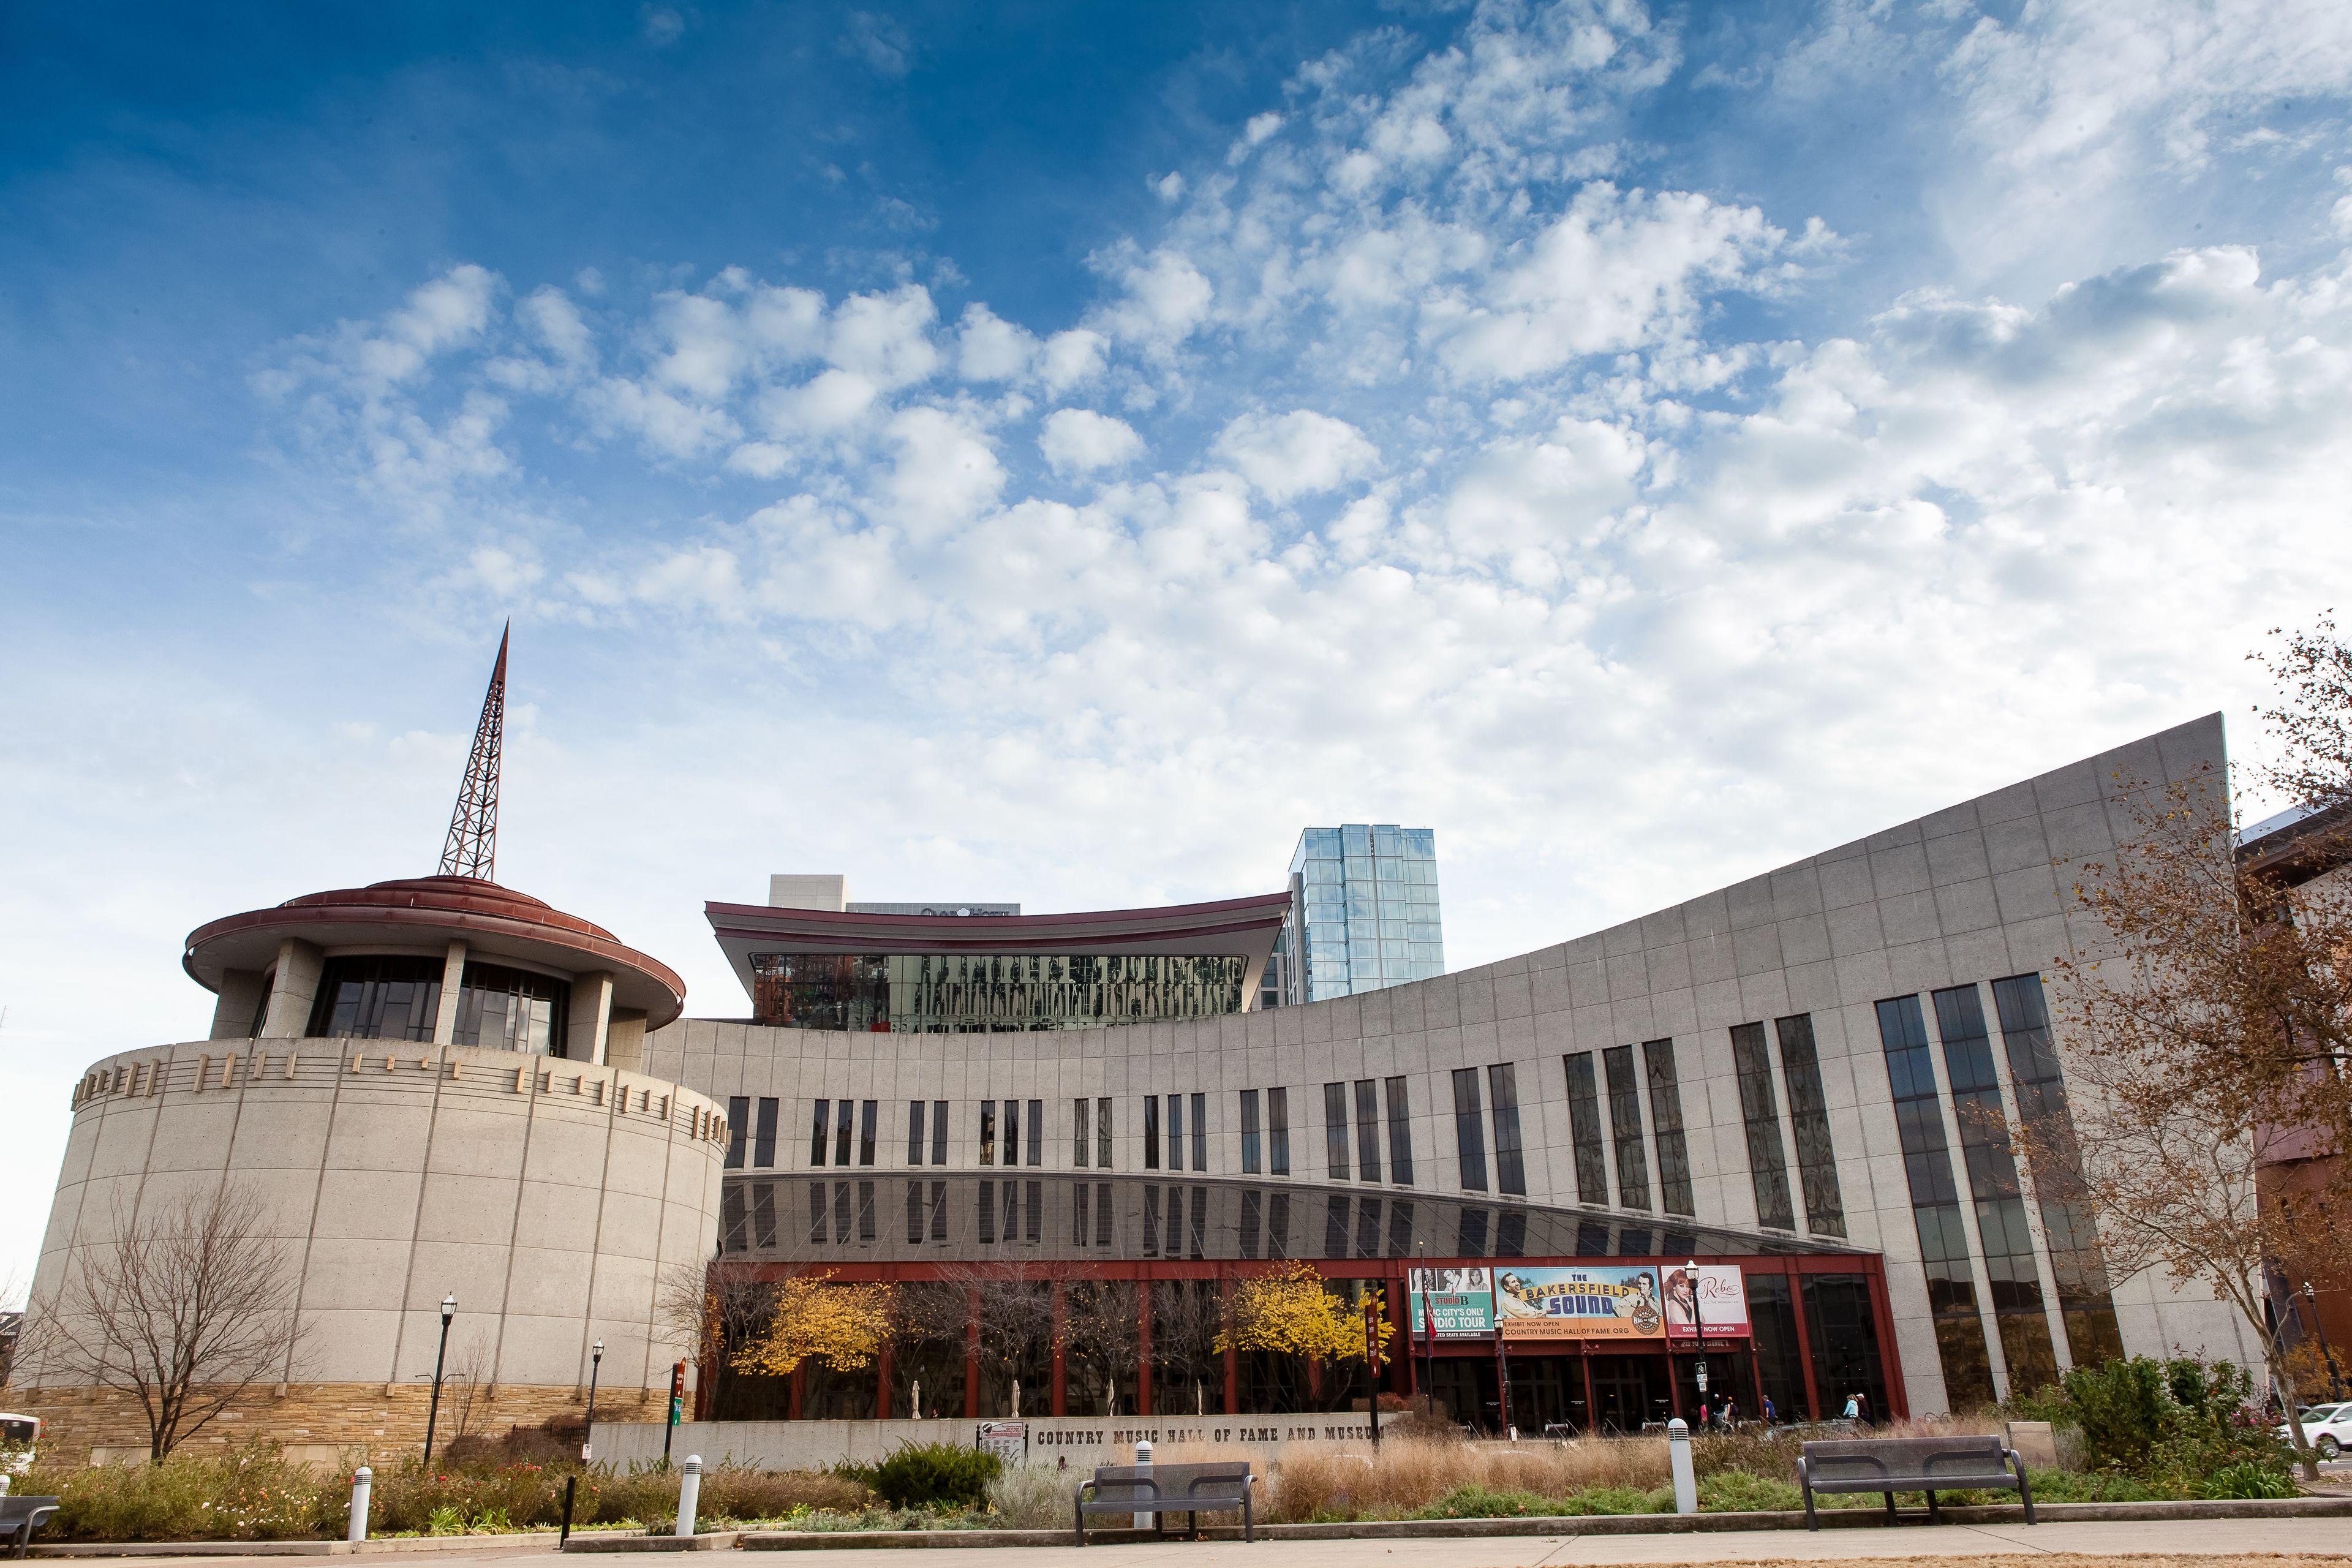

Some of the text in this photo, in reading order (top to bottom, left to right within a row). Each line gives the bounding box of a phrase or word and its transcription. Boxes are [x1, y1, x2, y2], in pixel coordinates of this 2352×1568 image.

[1526, 1284, 1629, 1298] BAKERSFIELD
[1696, 1277, 1740, 1299] Reba
[1460, 1295, 1469, 1305] B
[1548, 1295, 1613, 1314] SOUND
[1419, 1317, 1485, 1329] SUDIO TOUR
[1038, 1426, 1385, 1444] COUNTRY MUSIC HALL OF FAME AND MUSEUM
